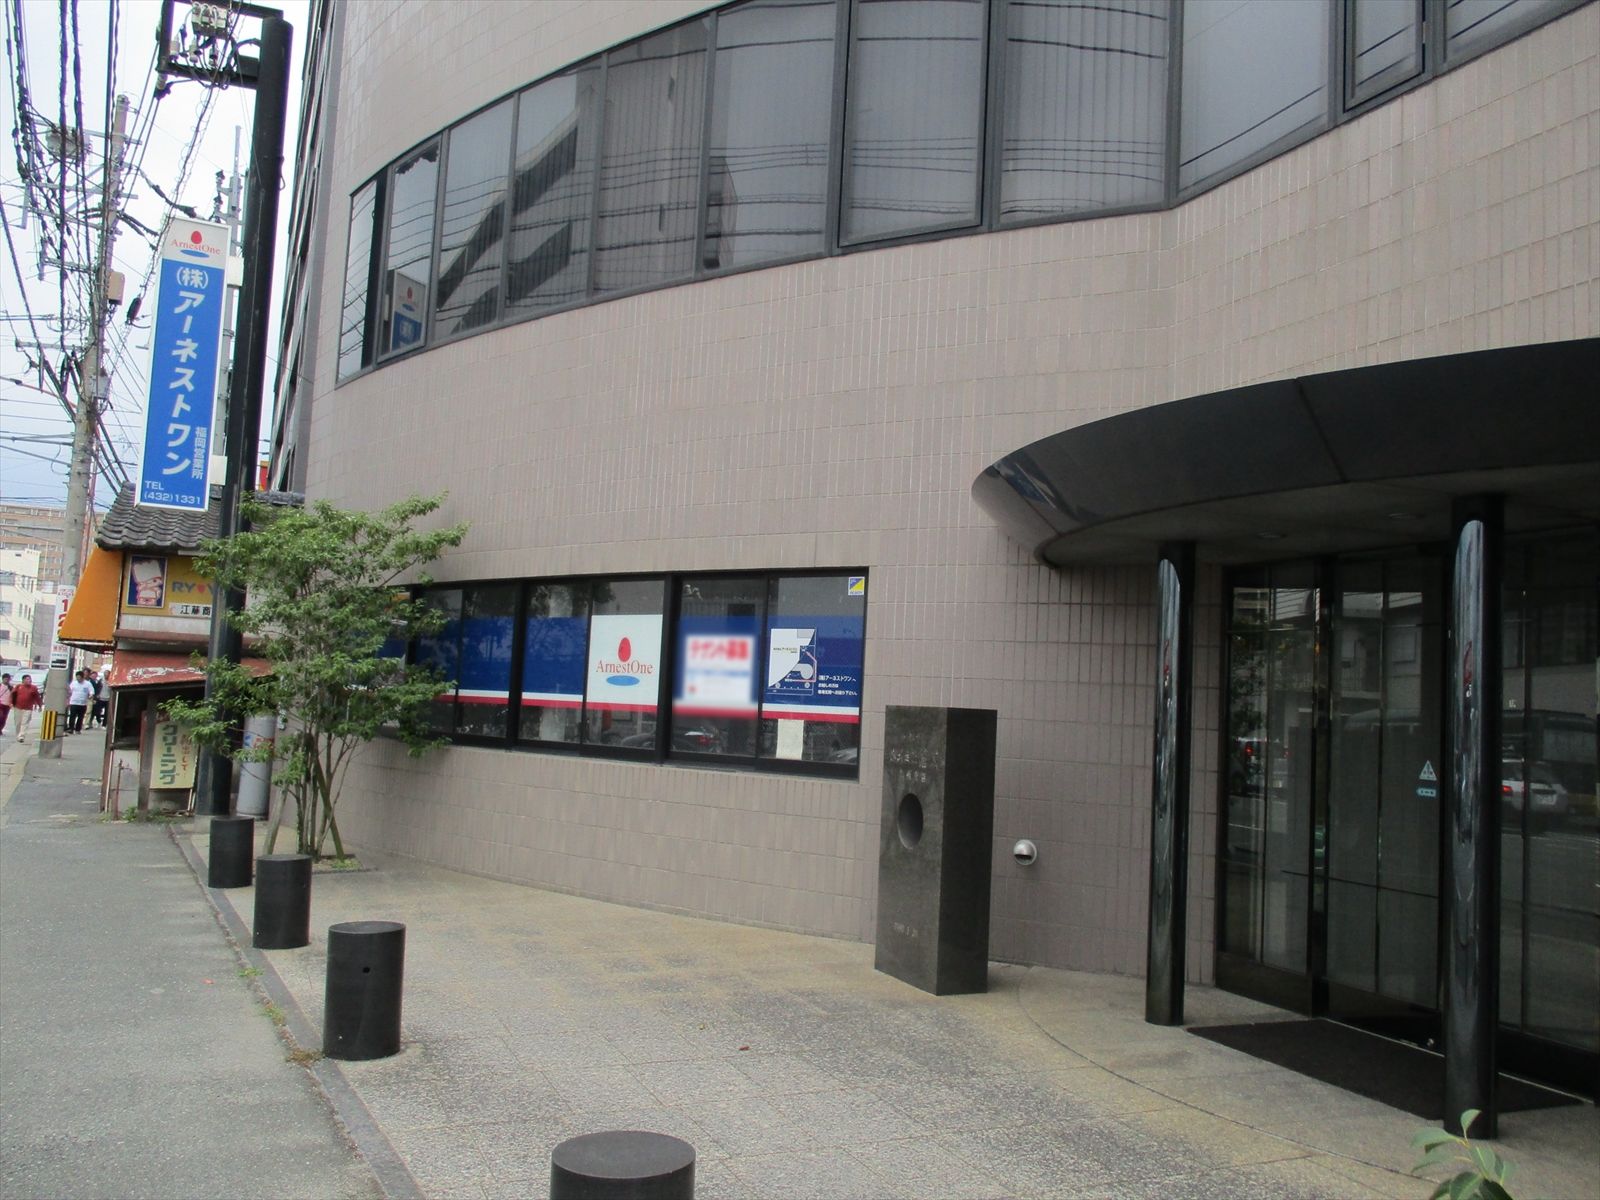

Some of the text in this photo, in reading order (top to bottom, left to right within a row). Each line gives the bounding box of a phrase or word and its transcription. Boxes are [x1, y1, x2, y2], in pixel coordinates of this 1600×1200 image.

[171, 237, 221, 255] ArnestOne
[145, 480, 165, 491] TEL
[143, 491, 202, 505] (432)1331
[596, 659, 654, 676] ArnestOne
